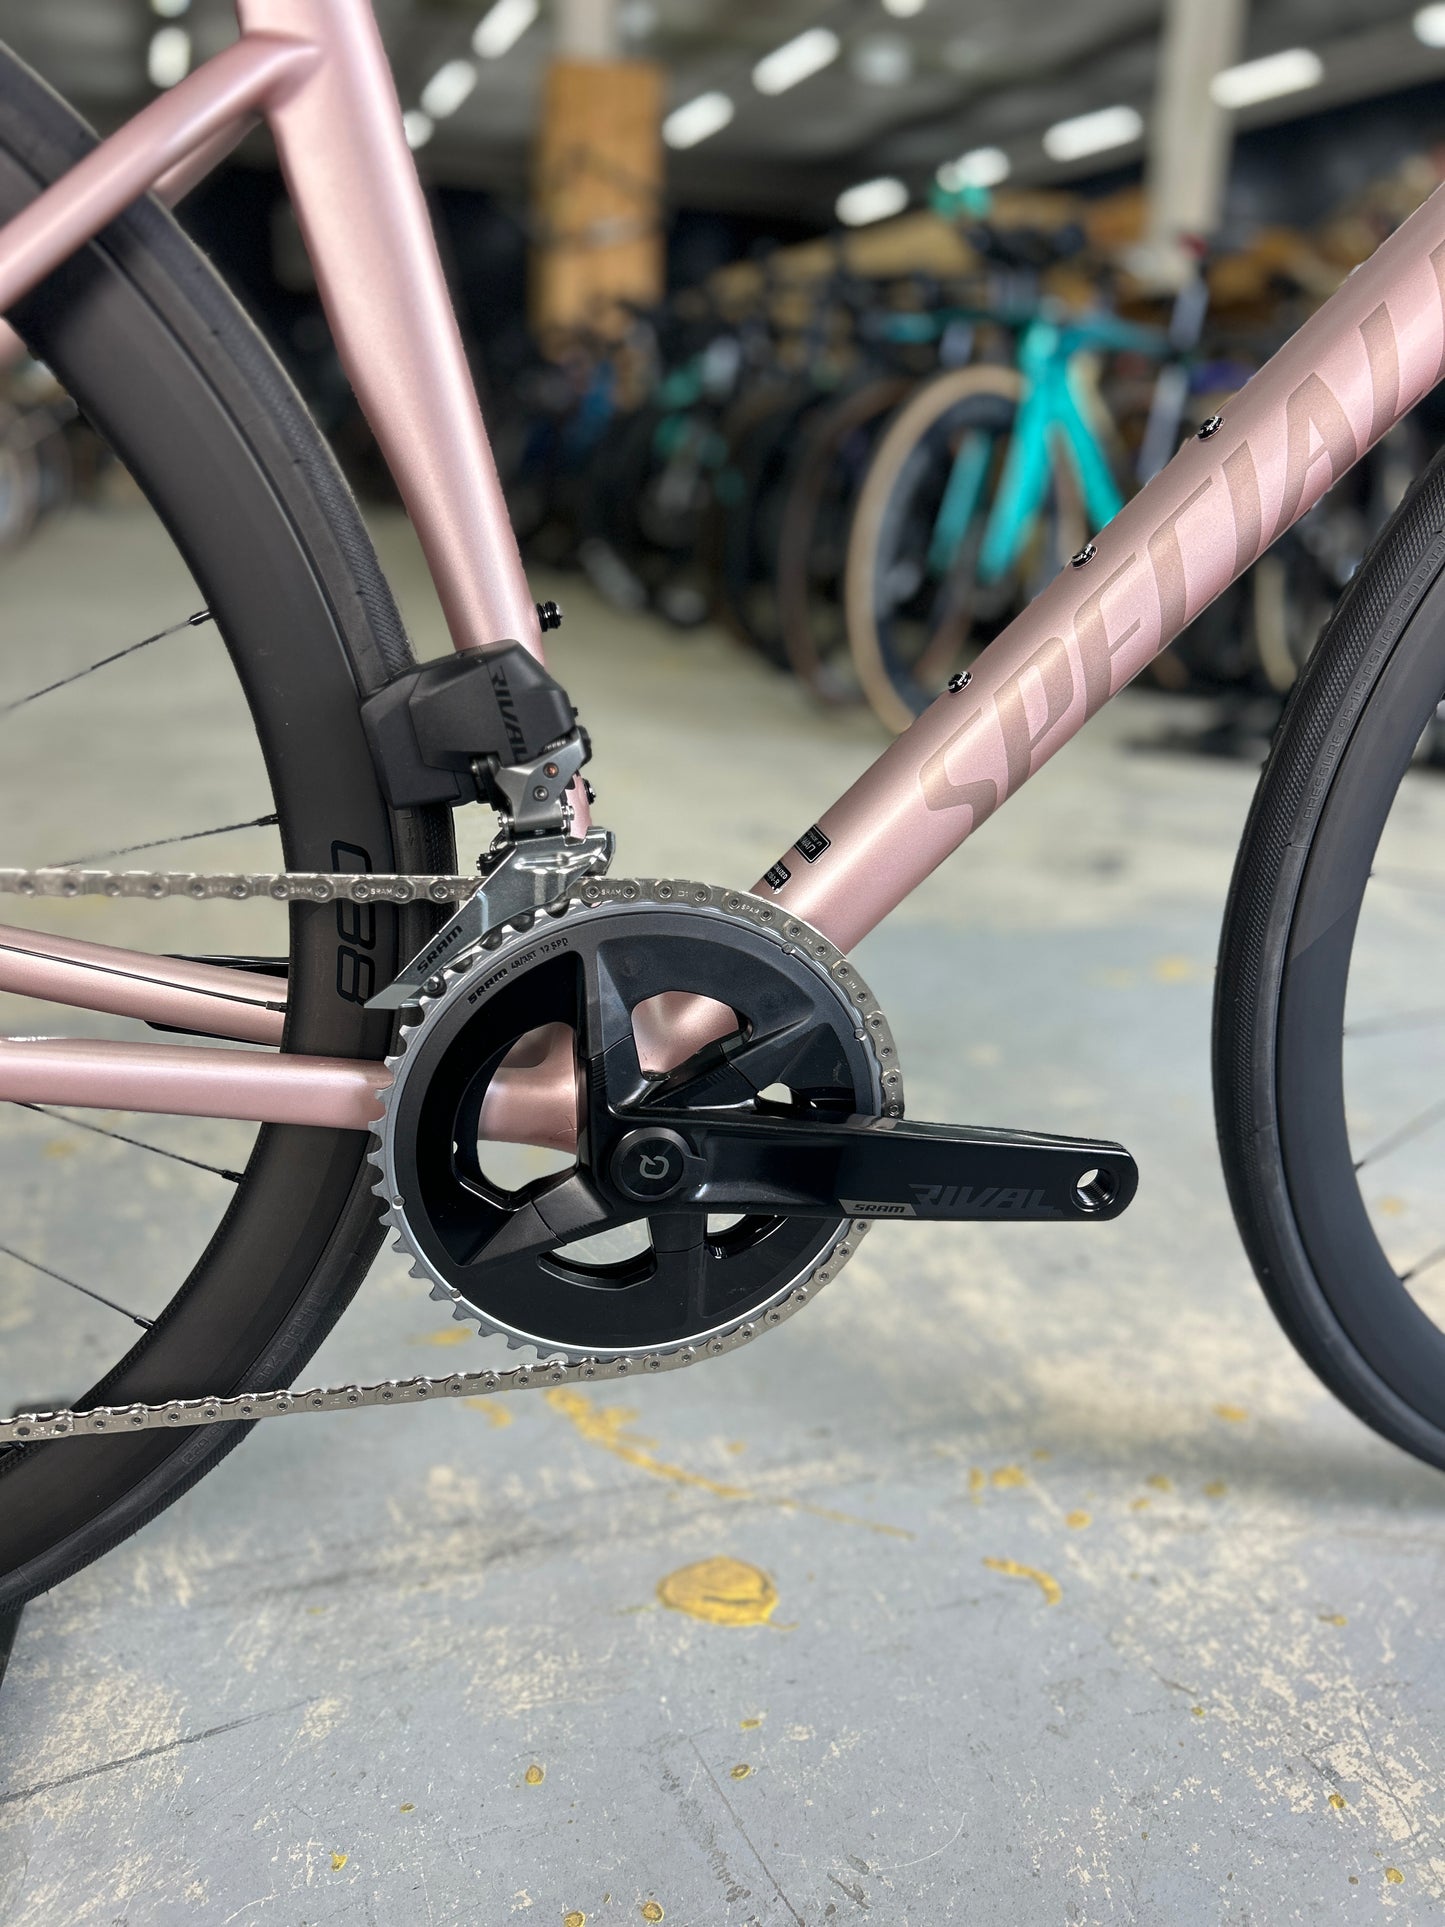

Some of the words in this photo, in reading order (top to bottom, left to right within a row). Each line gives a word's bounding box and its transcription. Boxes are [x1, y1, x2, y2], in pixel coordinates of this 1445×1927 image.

[491, 665, 529, 764] RIVAL
[416, 924, 463, 974] SRAM
[467, 967, 508, 1005] SRAM
[540, 944, 550, 954] 12
[550, 937, 569, 951] SPD
[852, 1203, 905, 1214] SRAM
[908, 1183, 1056, 1210] RIVAL
